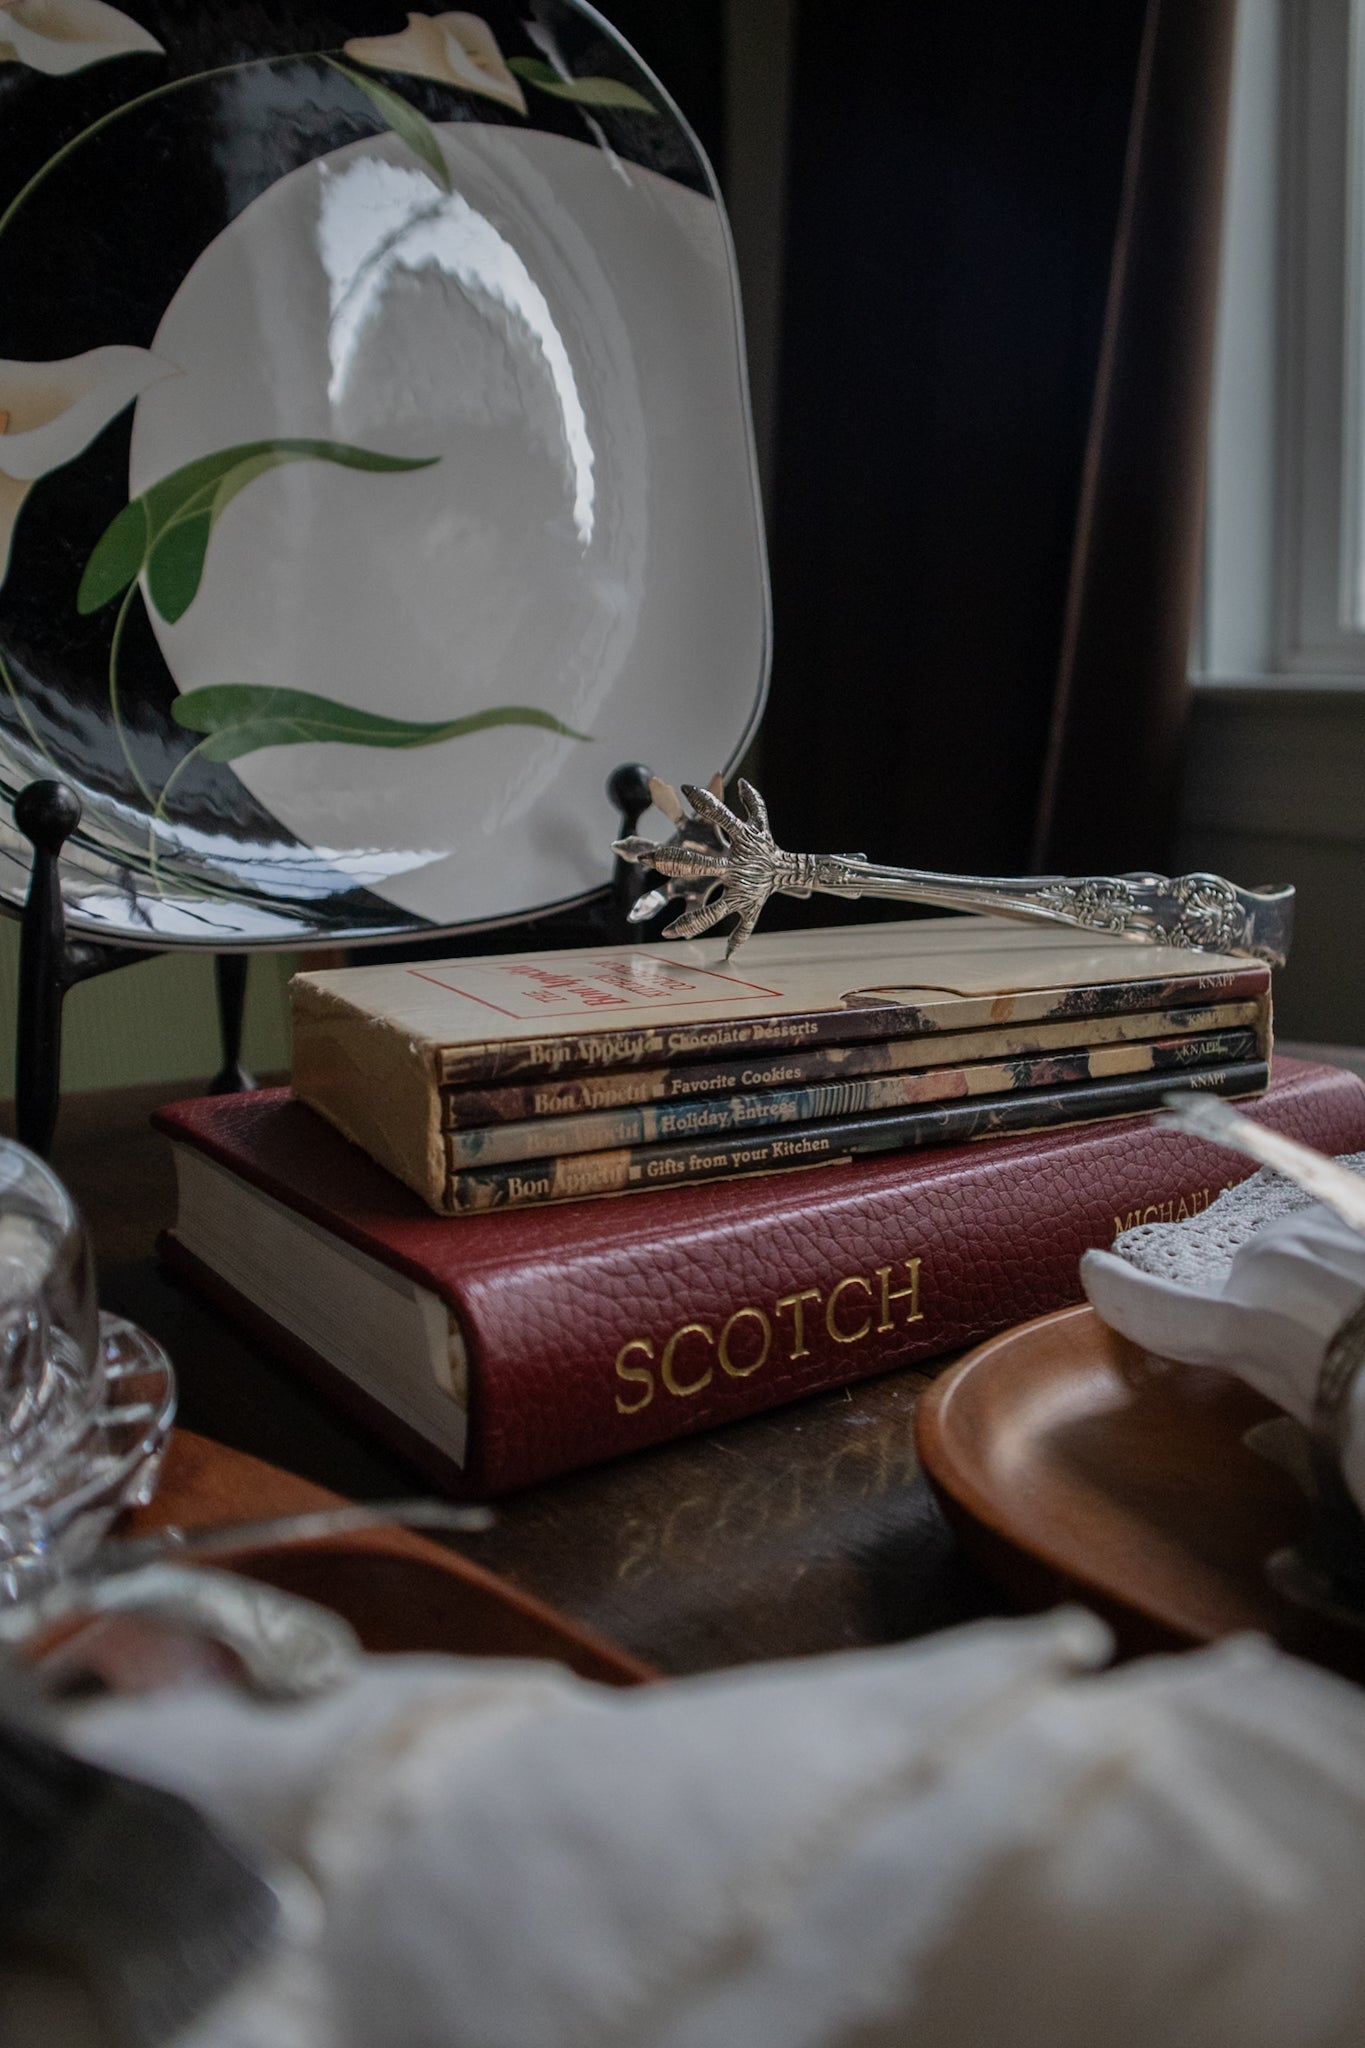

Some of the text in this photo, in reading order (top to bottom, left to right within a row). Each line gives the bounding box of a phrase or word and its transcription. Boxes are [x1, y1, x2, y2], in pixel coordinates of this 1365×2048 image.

[588, 974, 672, 997] KITCHEN
[589, 961, 696, 990] COLLETION
[1199, 974, 1235, 989] KNAPP
[521, 989, 567, 1003] THE
[529, 1043, 571, 1064] Bon
[668, 1029, 749, 1050] Chocolate
[753, 1021, 819, 1041] Desserts
[1182, 1040, 1220, 1057] KNAPP
[534, 1092, 576, 1114] Bon
[671, 1075, 737, 1095] Favorite
[741, 1066, 802, 1086] Cookies
[1190, 1072, 1226, 1088] KNAPP
[661, 1109, 729, 1132] Holiday
[508, 1177, 549, 1198] Bon
[647, 1158, 686, 1177] Gifts
[689, 1154, 728, 1171] from
[732, 1148, 768, 1168] your
[771, 1137, 831, 1158] Kitchen
[614, 1256, 924, 1415] SCOTCH
